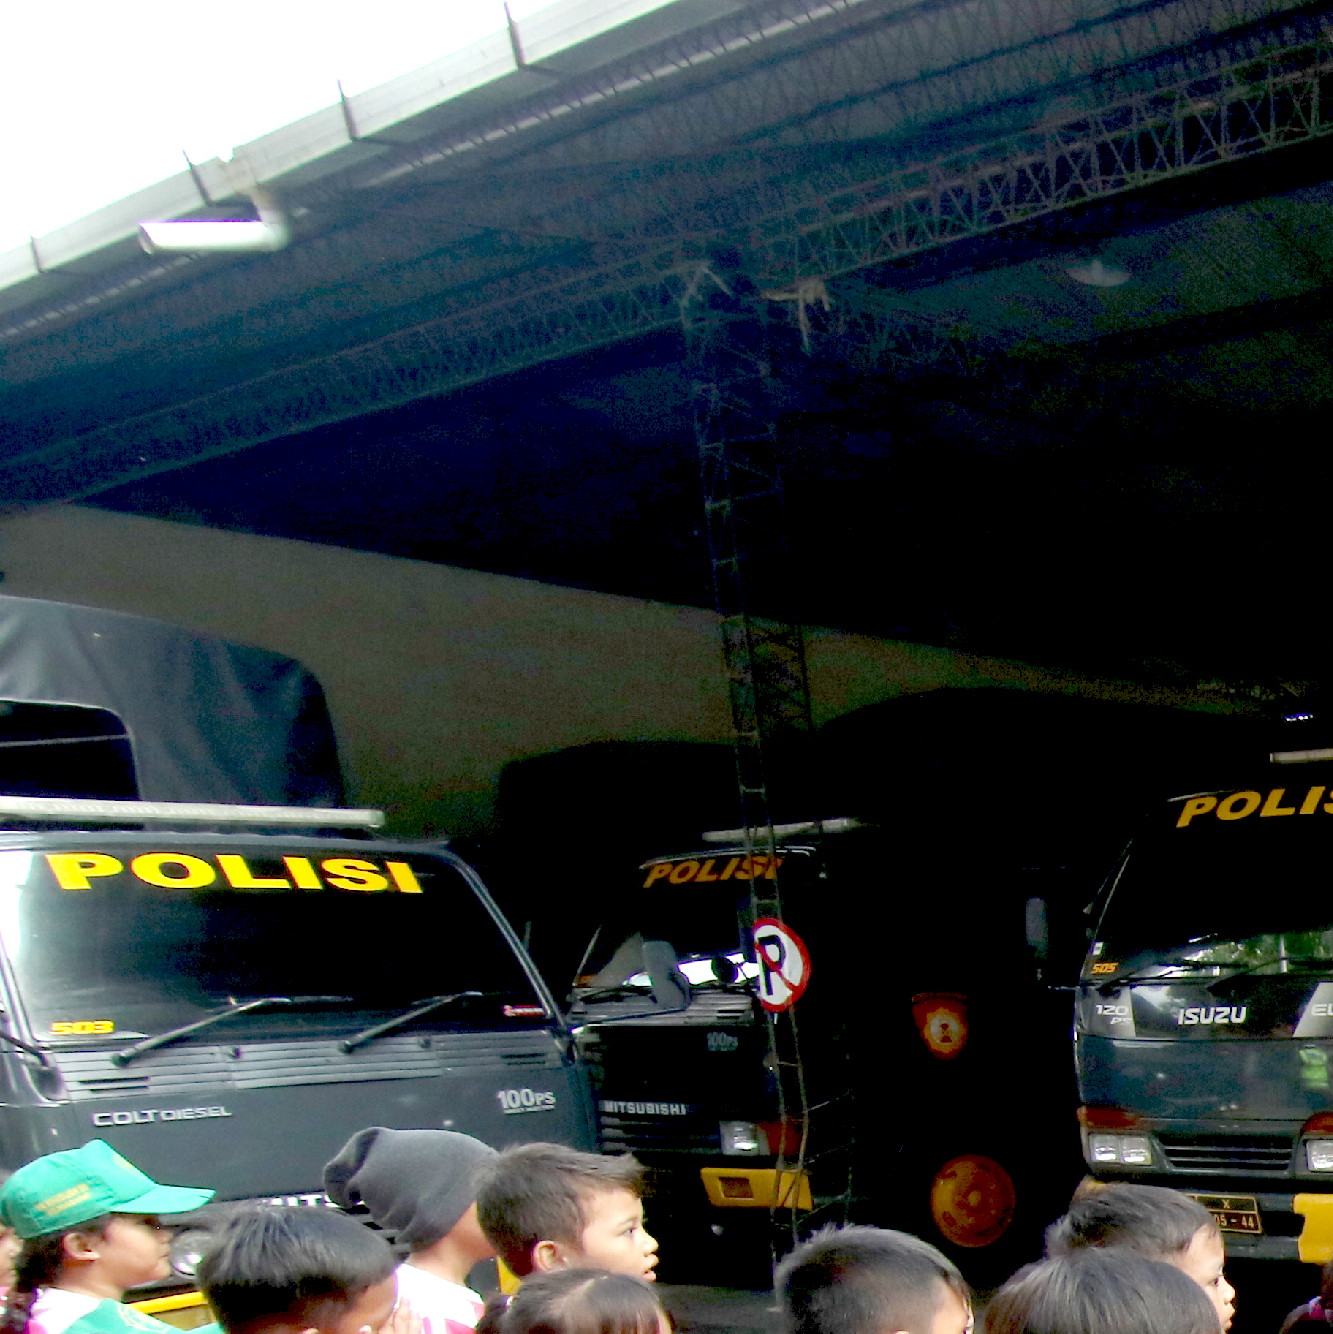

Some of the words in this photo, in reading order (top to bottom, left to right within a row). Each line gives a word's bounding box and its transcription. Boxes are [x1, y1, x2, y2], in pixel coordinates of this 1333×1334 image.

[45, 852, 423, 894] POLISI
[643, 856, 784, 888] POLISI
[757, 934, 787, 996] P
[1096, 1004, 1129, 1016] 120
[1177, 1006, 1247, 1025] ISUZU
[49, 1020, 115, 1035] 503
[498, 1088, 557, 1109] 100PS
[604, 1101, 688, 1116] MITSUBISHI
[92, 1109, 159, 1127] COLT
[160, 1101, 233, 1121] DIESEL
[1241, 1215, 1256, 1229] 44
